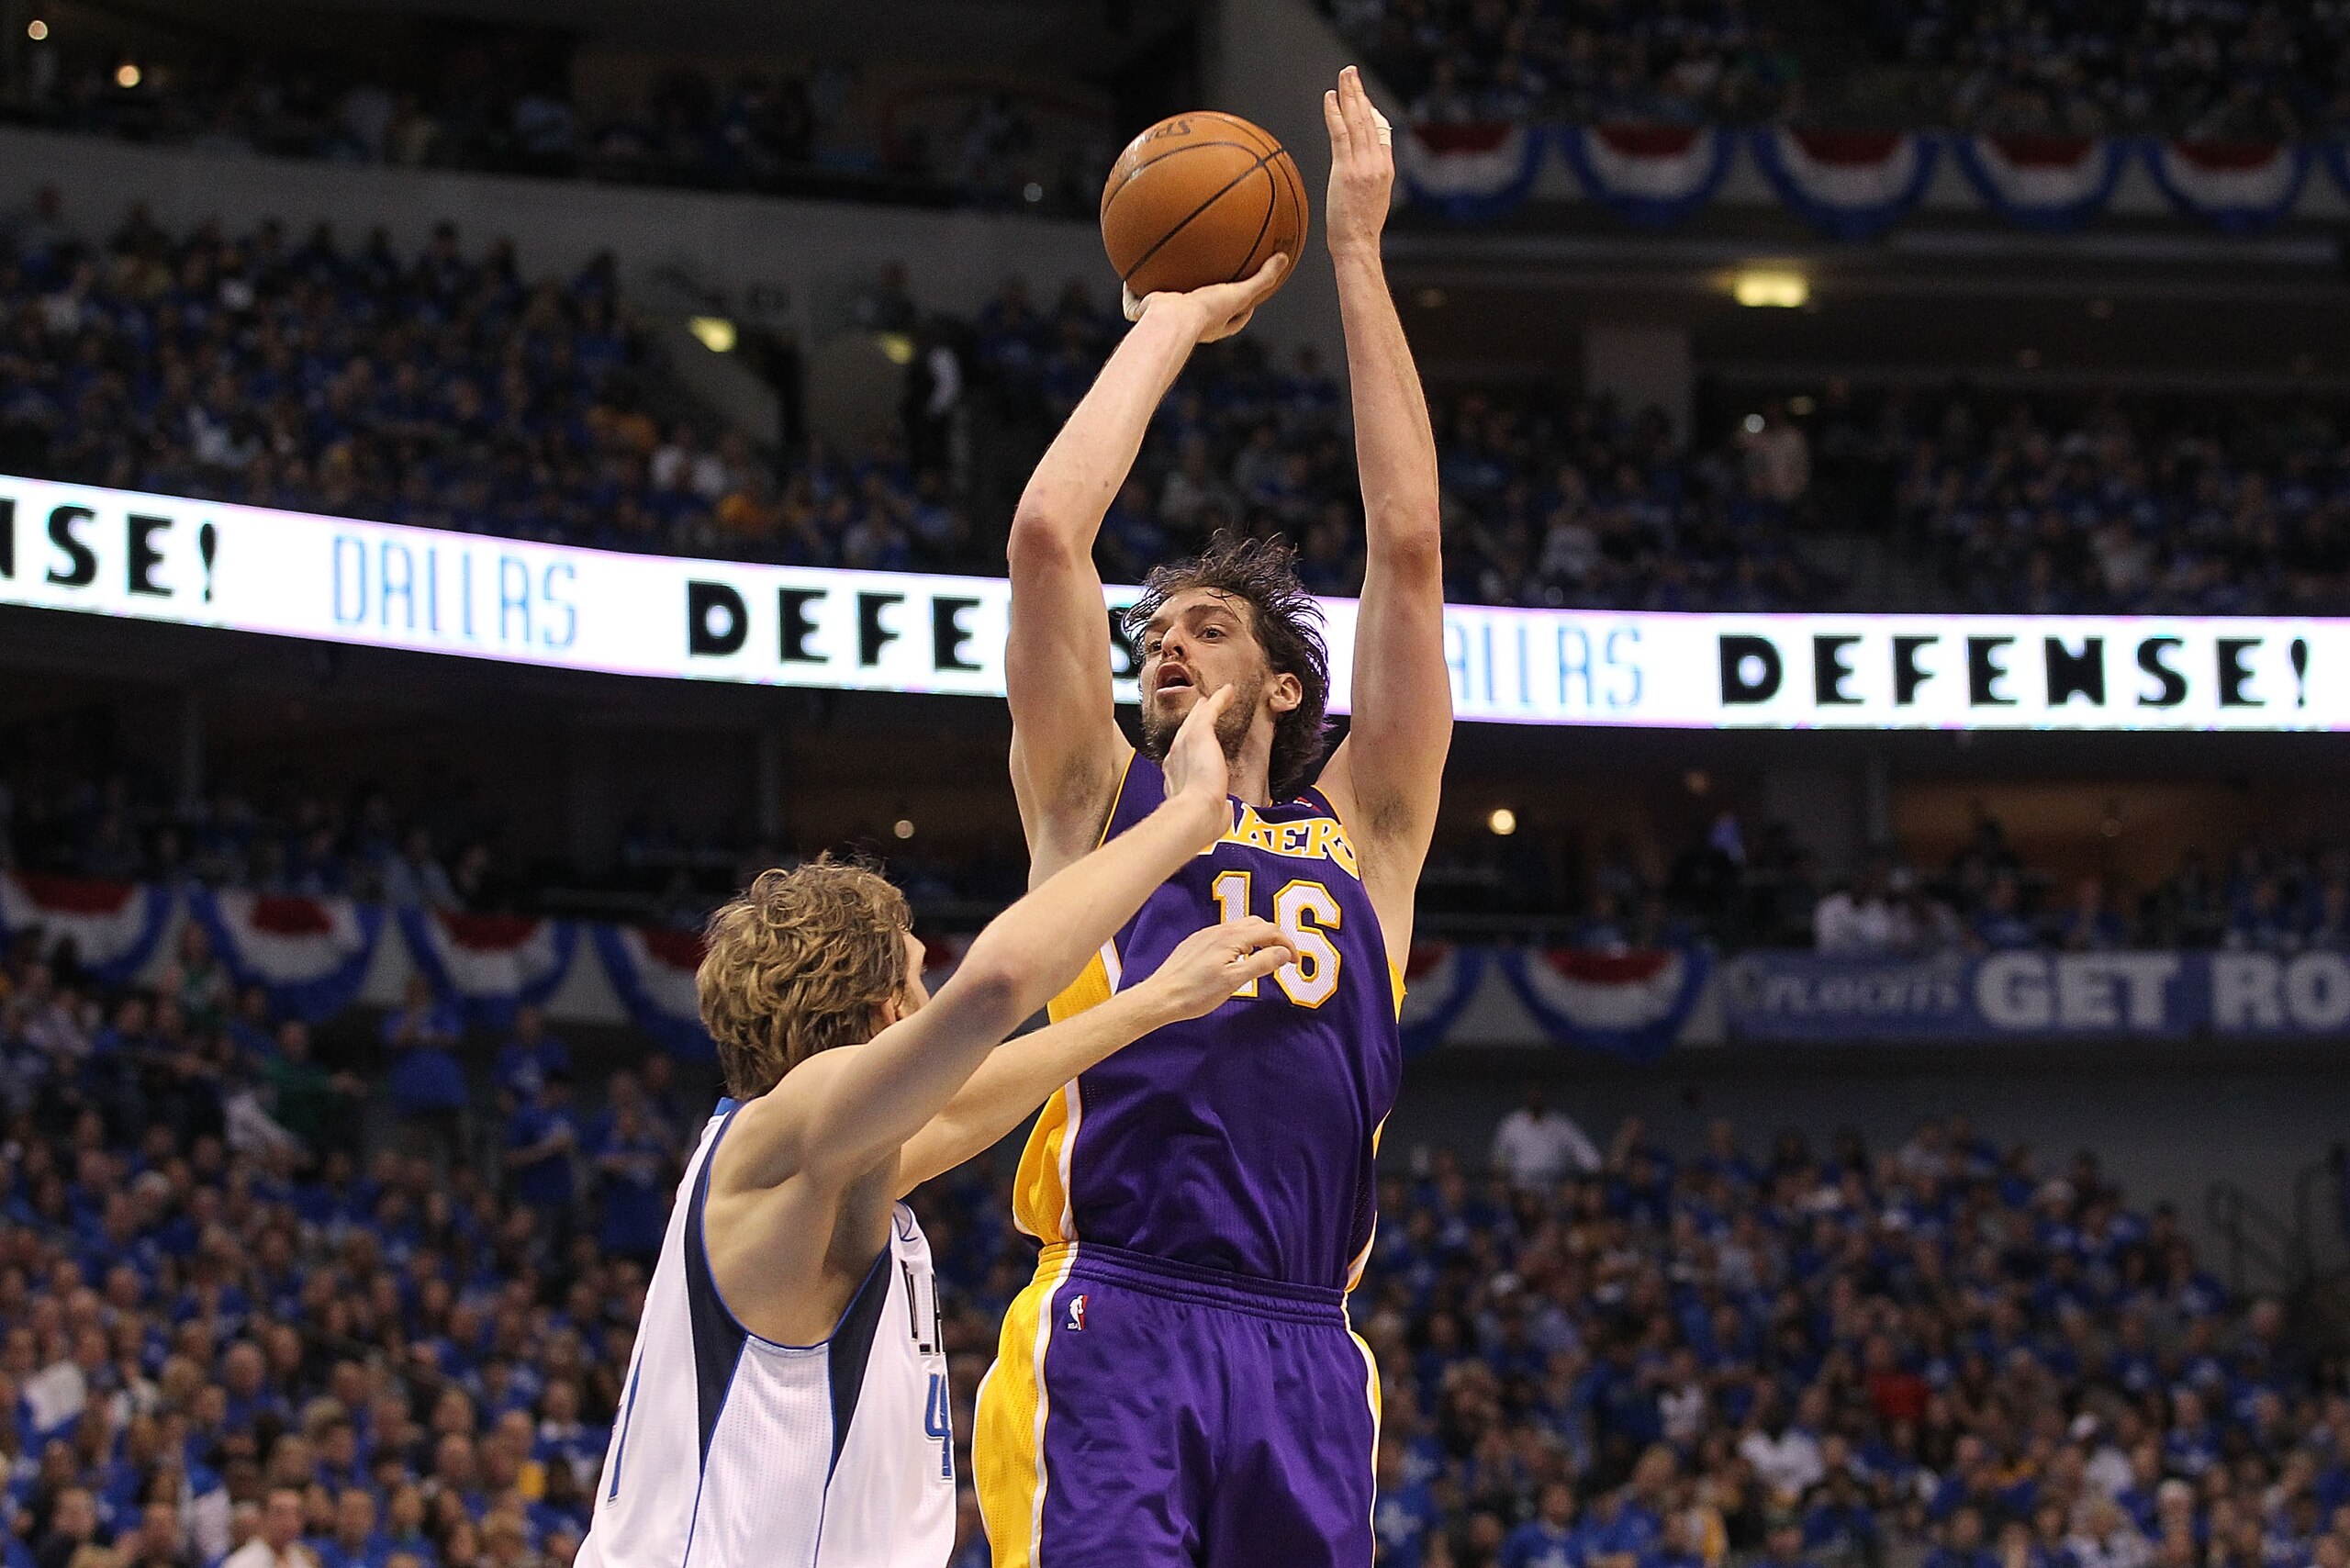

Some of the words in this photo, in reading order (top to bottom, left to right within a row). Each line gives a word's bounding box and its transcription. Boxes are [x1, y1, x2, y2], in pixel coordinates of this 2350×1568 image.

[330, 533, 580, 650] DALLAS
[1444, 621, 1644, 709] ALLAS
[1717, 634, 2313, 710] DEFENSE!
[1195, 799, 1360, 881] AKERS
[1975, 951, 2181, 1029] GET
